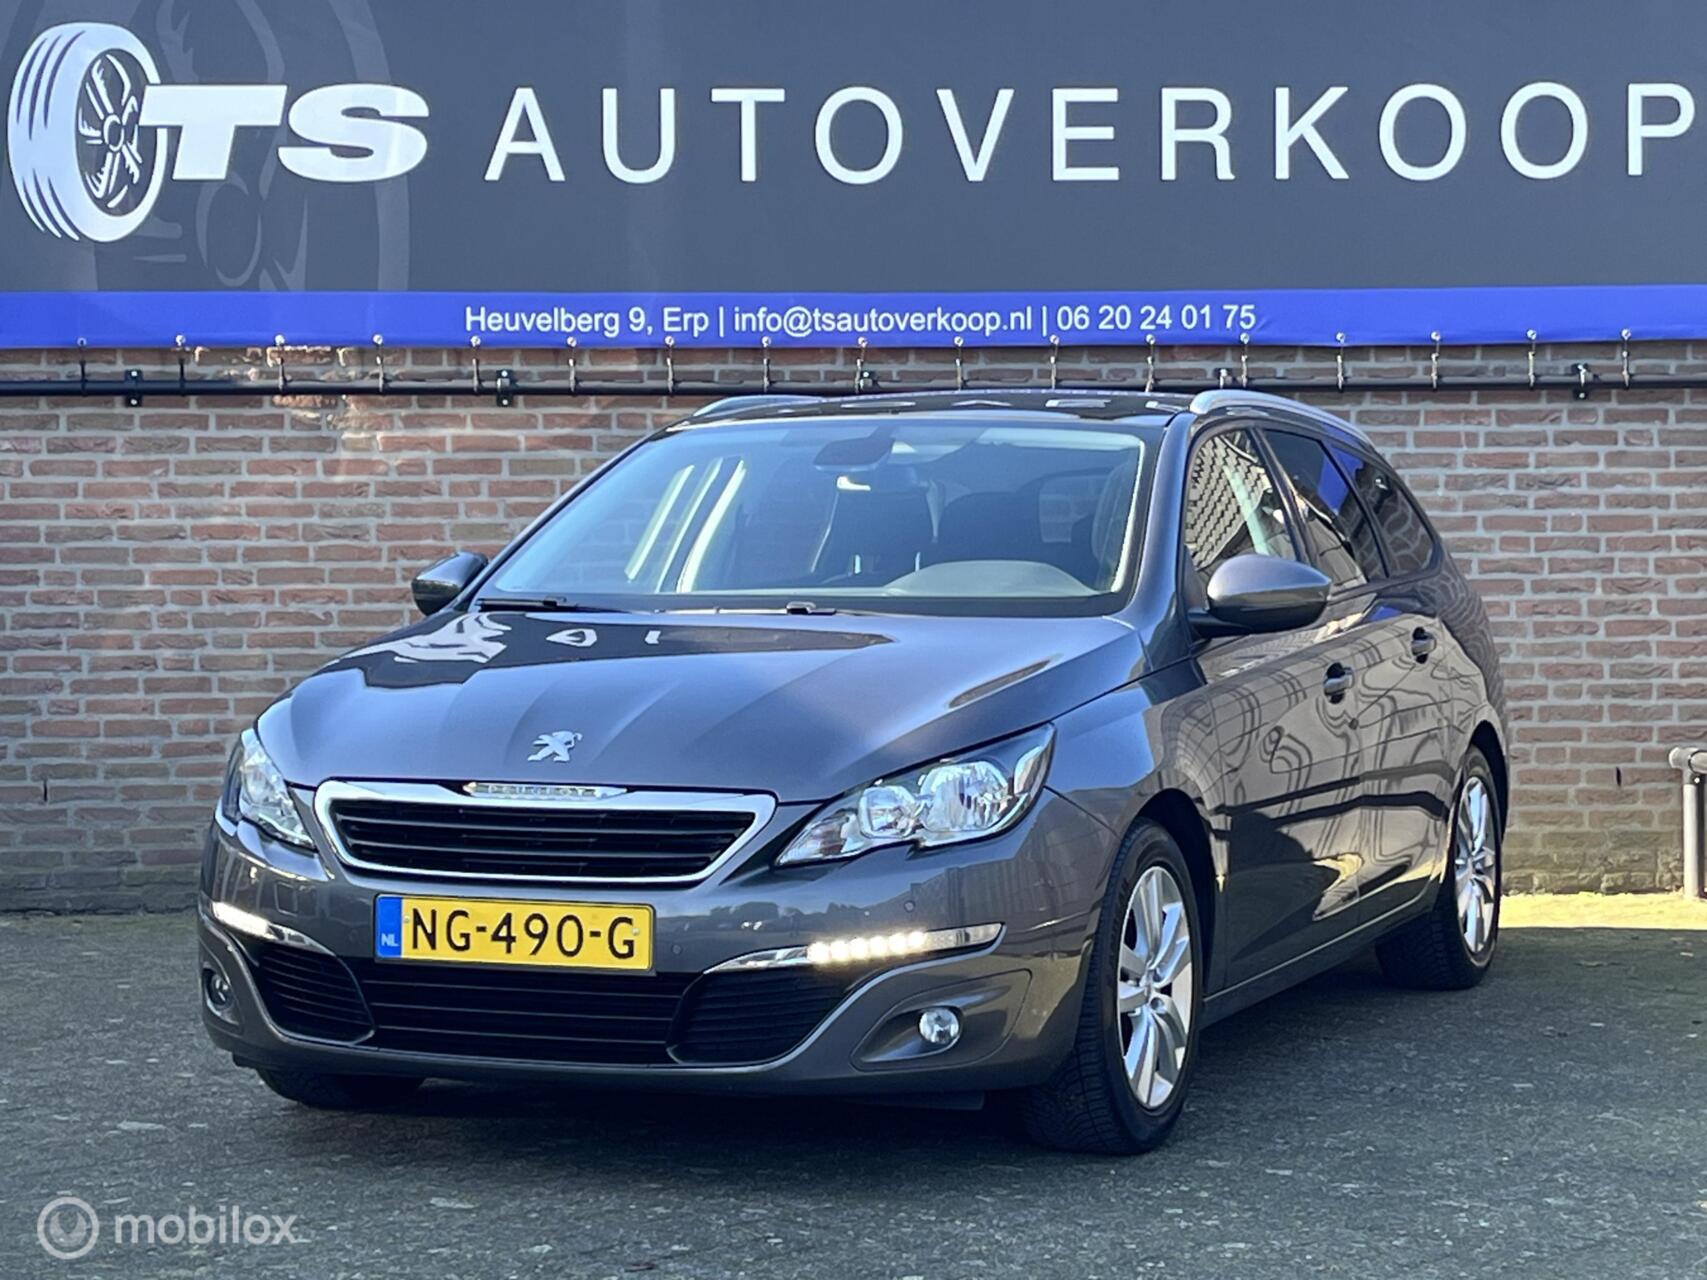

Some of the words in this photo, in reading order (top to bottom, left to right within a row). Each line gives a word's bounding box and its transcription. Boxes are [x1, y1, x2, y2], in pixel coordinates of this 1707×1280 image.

[484, 81, 1695, 184] AUTOVERKOOP
[465, 306, 620, 337] Heuvelberg
[629, 307, 653, 335] 9,
[663, 306, 709, 337] Erp
[734, 306, 1032, 337] info@tsautoverkoop.nl
[1056, 305, 1090, 330] 06
[1098, 305, 1132, 330] 20
[1140, 305, 1172, 330] 24
[1181, 304, 1210, 330] 01
[1223, 304, 1256, 330] 75
[381, 933, 399, 948] NL
[412, 908, 636, 960] NG-490-G
